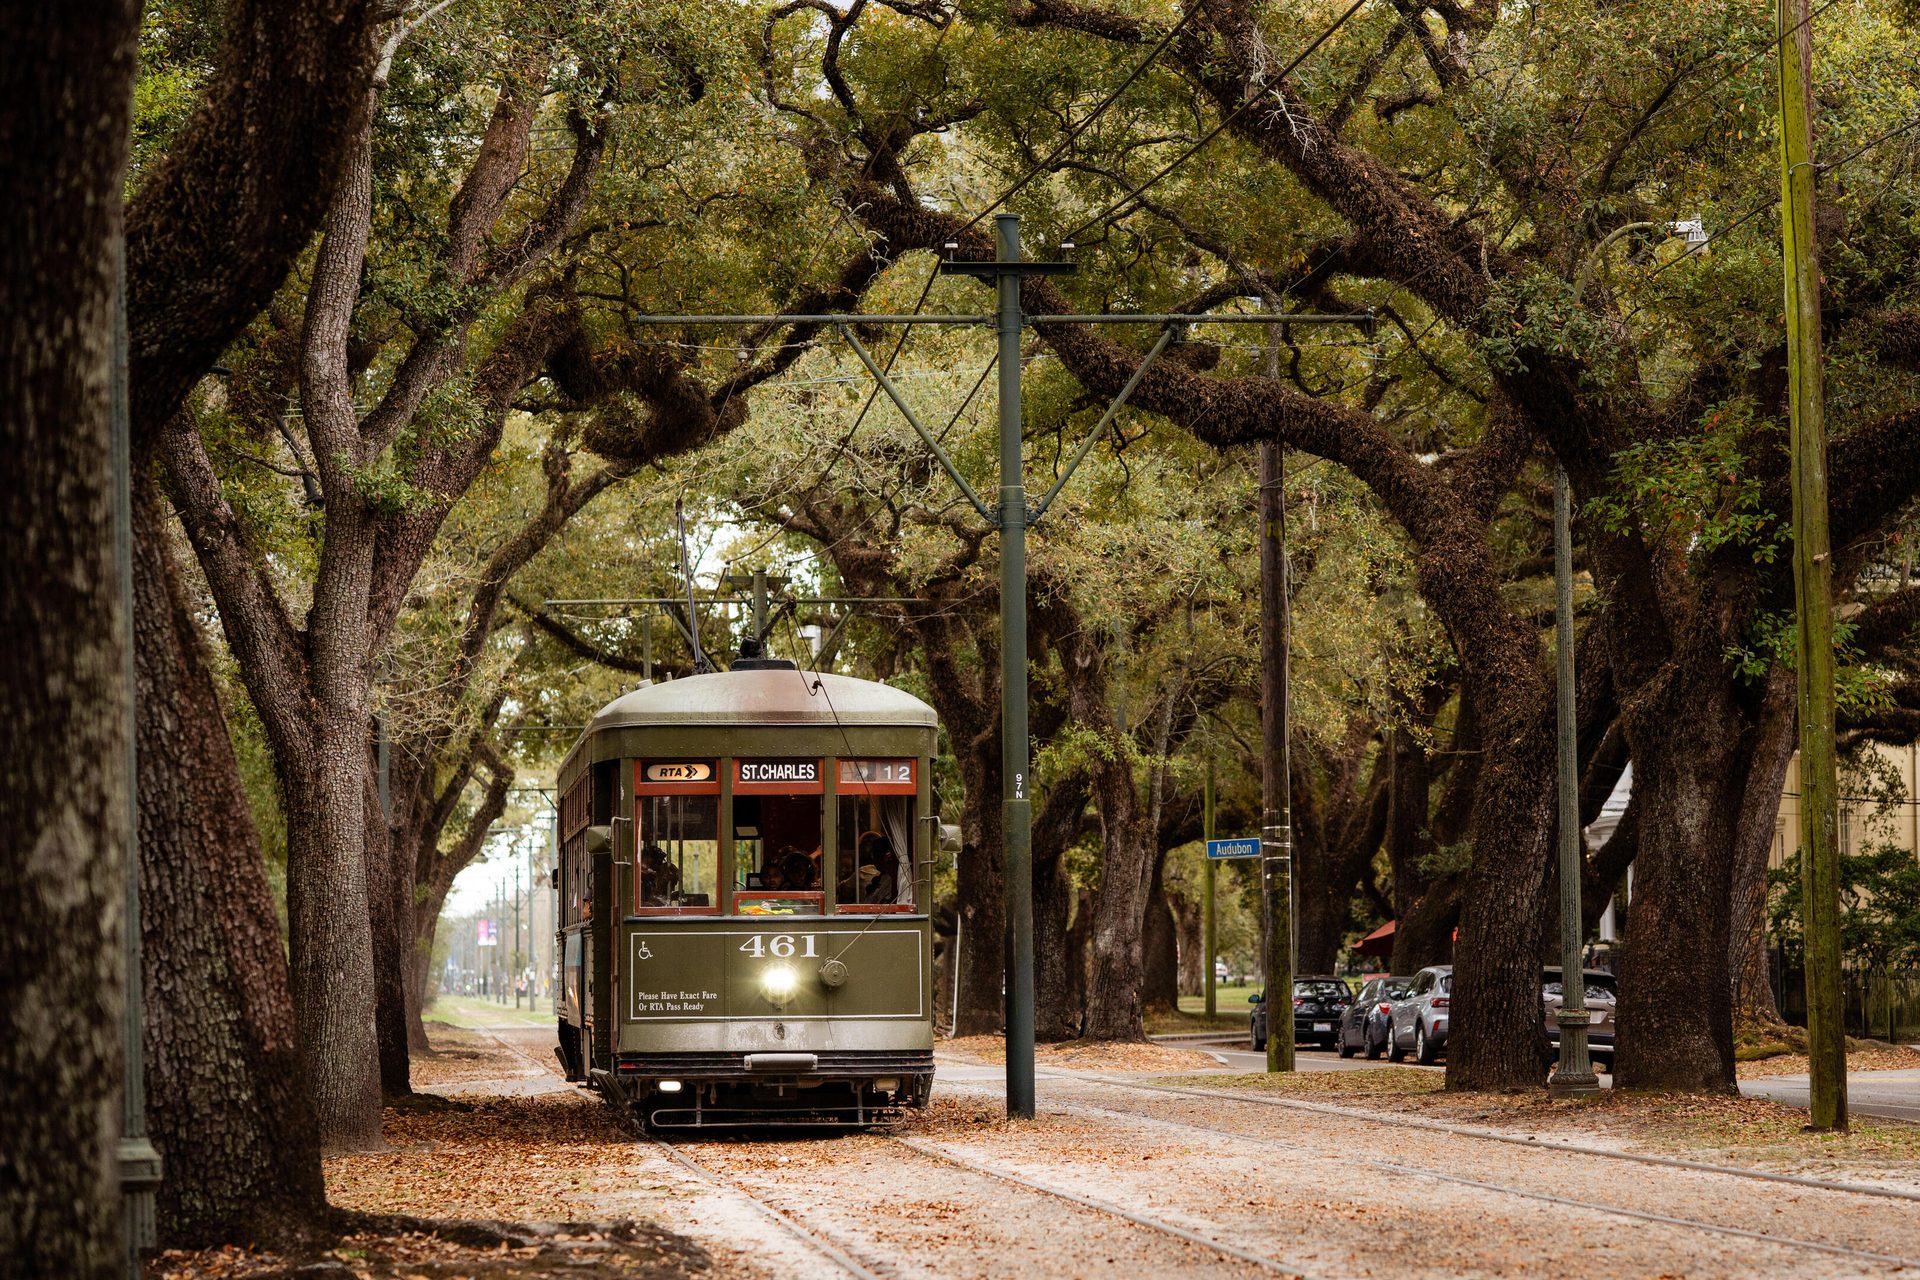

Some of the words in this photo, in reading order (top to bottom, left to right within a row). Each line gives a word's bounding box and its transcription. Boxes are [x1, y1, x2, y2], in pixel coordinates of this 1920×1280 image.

[659, 767, 682, 777] RTA
[741, 764, 815, 780] ST.CHARLES
[883, 765, 910, 780] 12
[1216, 842, 1252, 856] Audubon
[739, 934, 820, 958] 461
[638, 991, 659, 1000] Please
[661, 991, 678, 1000] Have
[680, 991, 700, 1000] Exact
[702, 990, 718, 1000] Fare
[638, 1002, 648, 1011] Or
[649, 1002, 664, 1011] RTA
[666, 1002, 681, 1011] Pass
[683, 1001, 704, 1012] Ready
